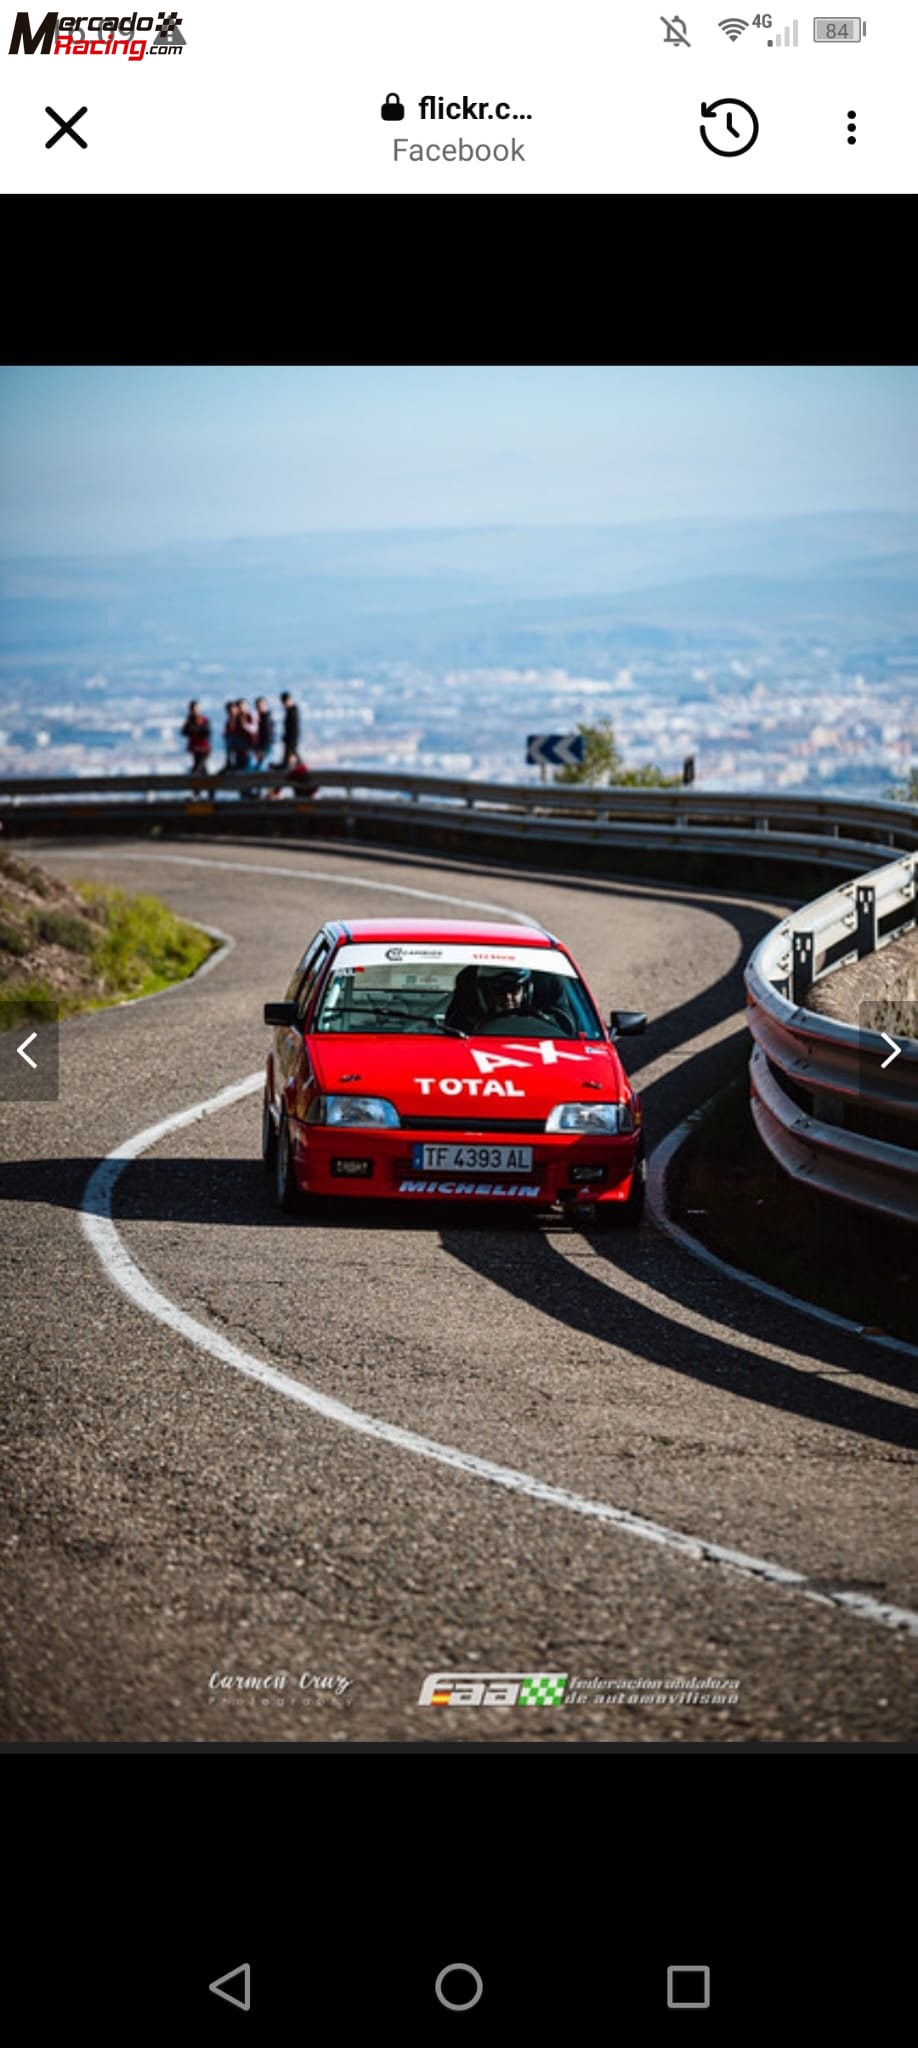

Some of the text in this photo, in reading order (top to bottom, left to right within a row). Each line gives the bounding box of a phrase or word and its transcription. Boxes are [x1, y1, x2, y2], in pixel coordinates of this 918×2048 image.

[751, 14, 773, 29] 4G
[825, 23, 849, 39] 84
[392, 137, 527, 163] Facebook
[469, 1040, 592, 1074] AX
[413, 1077, 526, 1097] TOTAL
[424, 1147, 530, 1169] TF 4393 AL
[398, 1180, 541, 1198] MICHELIN
